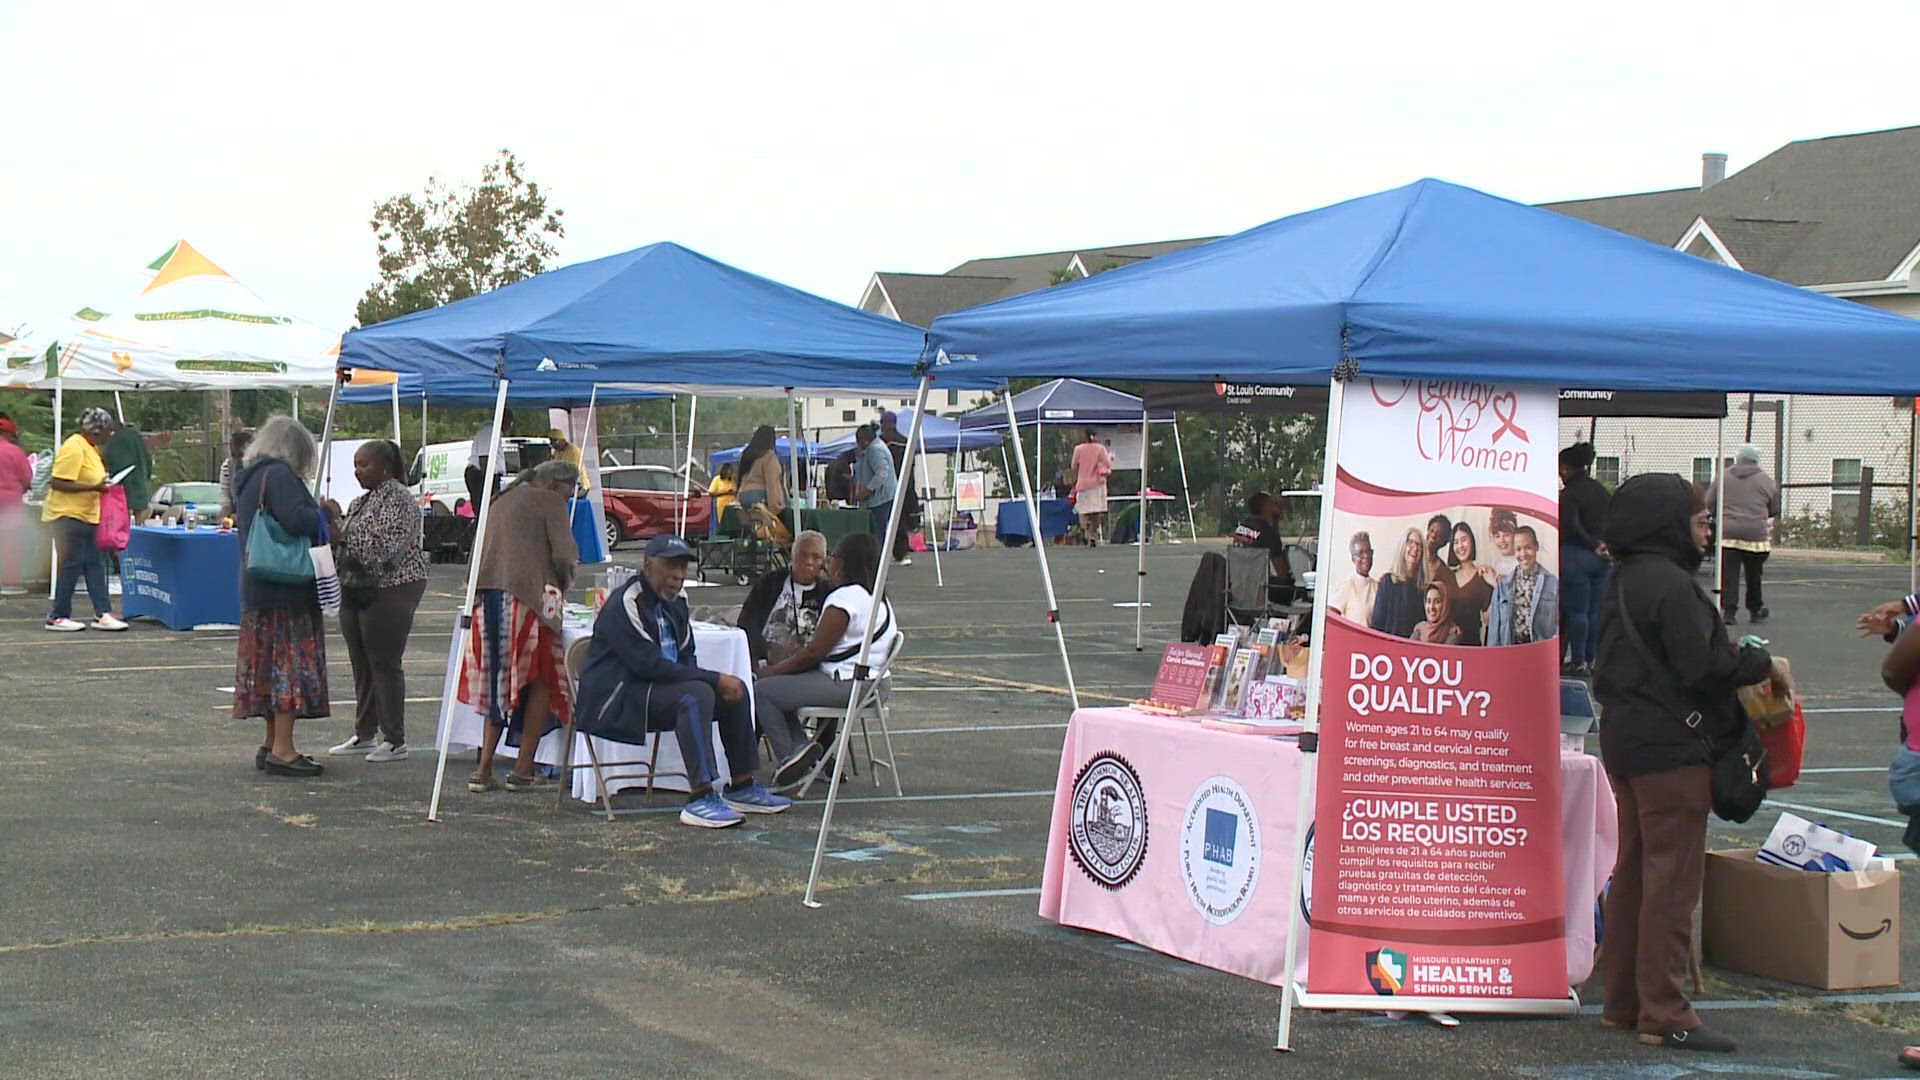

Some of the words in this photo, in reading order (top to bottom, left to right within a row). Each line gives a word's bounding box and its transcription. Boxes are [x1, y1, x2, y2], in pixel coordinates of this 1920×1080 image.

[1236, 385, 1254, 395] Louis
[1254, 385, 1295, 398] Community
[1417, 394, 1528, 473] Women
[1350, 652, 1393, 682] DO
[1401, 656, 1463, 686] YOU
[1347, 683, 1491, 717] QUALIFY?
[1346, 721, 1382, 734] Women
[1385, 725, 1408, 737] ages
[1410, 725, 1419, 735] 21
[1422, 726, 1432, 736] to
[1434, 726, 1447, 737] 64
[1450, 729, 1472, 740] may
[1475, 728, 1508, 742] qualify
[1345, 737, 1357, 748] for
[1359, 738, 1378, 750] free
[1380, 739, 1410, 751] breast
[1412, 741, 1431, 753] and
[1434, 742, 1472, 755] cervical
[1475, 746, 1509, 757] cancer
[1344, 756, 1396, 769] screenings,
[1398, 758, 1457, 771] diagnostics,
[1459, 760, 1479, 772] and
[1481, 762, 1532, 774] treatment
[1343, 772, 1361, 782] and
[1363, 773, 1389, 784] other
[1391, 775, 1453, 787] preventative
[1455, 776, 1487, 788] health
[1490, 780, 1533, 791] services.
[1076, 788, 1090, 810] THE
[1119, 773, 1137, 801] SEAL
[1342, 799, 1438, 822] ¿CUMPLE
[1445, 802, 1517, 824] USTED
[1075, 823, 1088, 847] THE
[1342, 822, 1381, 841] LOS
[1388, 824, 1528, 847] REQUISITOS?
[1204, 842, 1233, 864] PHAB
[1340, 844, 1355, 853] Las
[1357, 847, 1394, 857] mujeres
[1396, 846, 1409, 855] de
[1410, 846, 1420, 856] 21
[1430, 847, 1442, 857] 64
[1444, 847, 1468, 858] años
[1469, 848, 1506, 861] pueden
[1339, 856, 1375, 869] cumplir
[1377, 857, 1390, 867] los
[1392, 858, 1439, 871] requisitos
[1441, 862, 1463, 872] para
[1464, 860, 1495, 871] recibir
[1339, 868, 1376, 881] pruebas
[1378, 869, 1421, 883] gratuitas
[1423, 871, 1436, 881] de
[1437, 872, 1488, 884] detección,
[1338, 880, 1393, 893] diagnóstico
[1394, 884, 1401, 893] y
[1402, 882, 1460, 893] tratamiento
[1462, 884, 1478, 894] del
[1479, 884, 1512, 895] cáncer
[1514, 885, 1527, 895] de
[1337, 895, 1368, 903] mama
[1370, 896, 1376, 905] y
[1378, 894, 1390, 903] de
[1392, 894, 1421, 904] cuello
[1423, 895, 1461, 907] uterino,
[1463, 896, 1501, 907] además
[1502, 898, 1515, 907] de
[1337, 905, 1362, 915] otros
[1364, 905, 1405, 916] servicios
[1407, 907, 1420, 917] de
[1421, 907, 1466, 918] cuidados
[1468, 909, 1526, 922] preventivos.
[1413, 956, 1449, 964] MISSOURI
[1450, 957, 1500, 965] DEPARTMENT
[1413, 965, 1492, 983] HEALTH
[1498, 966, 1513, 983] &
[1414, 983, 1456, 994] SENIOR
[1459, 984, 1513, 995] SERVICES
